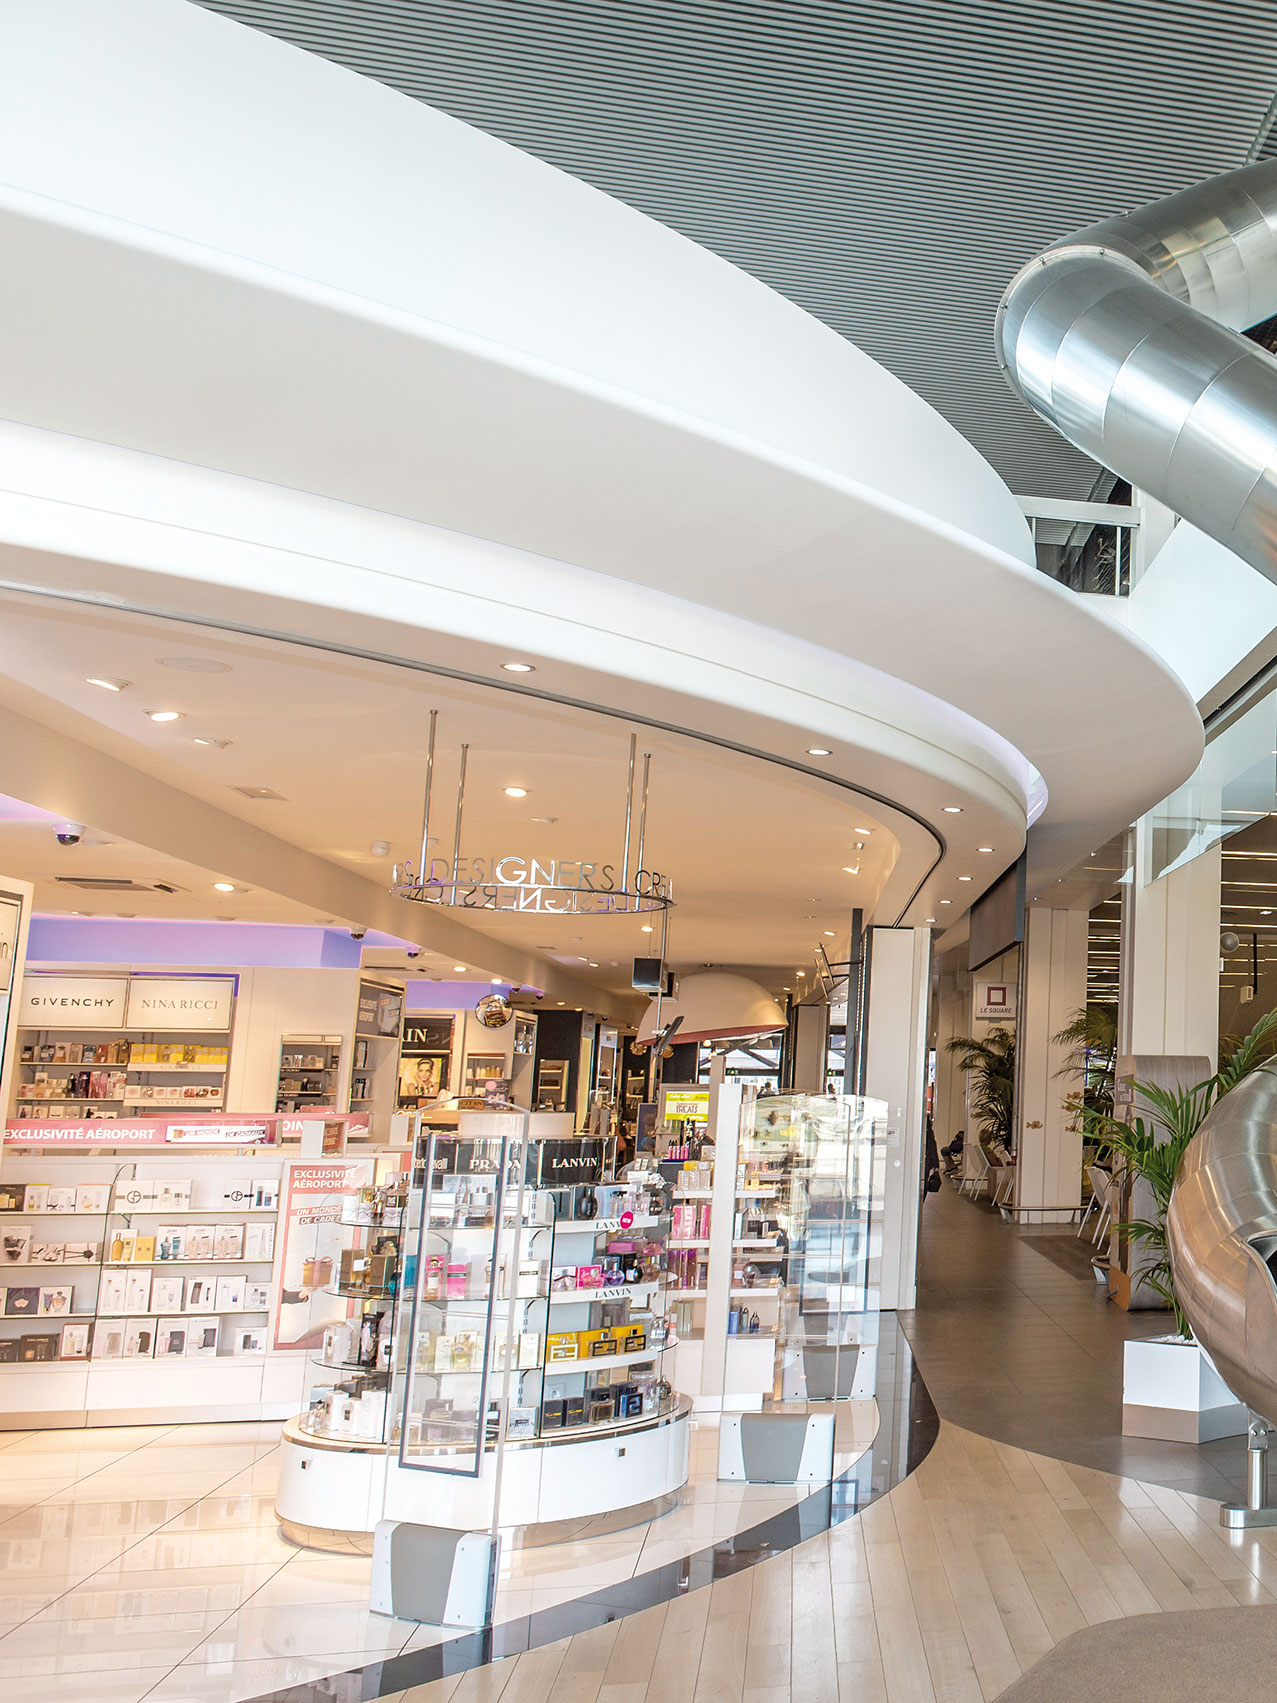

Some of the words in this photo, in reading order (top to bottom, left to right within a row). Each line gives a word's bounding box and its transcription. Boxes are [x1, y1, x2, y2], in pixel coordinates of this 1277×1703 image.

[430, 856, 614, 891] DESIGNERS
[30, 998, 115, 1007] GIVENCHY
[141, 999, 176, 1009] NINA
[179, 1000, 219, 1010] RICCI
[3, 1126, 84, 1140] EXCLUSIVITÉ
[86, 1126, 156, 1140] AÉROPORT
[469, 1159, 521, 1169] PRADA
[551, 1157, 599, 1169] LANVIN
[294, 1168, 356, 1179] EXCLUSIVITÉ
[292, 1179, 347, 1189] AÉROPORT
[311, 1205, 341, 1215] MONDE
[301, 1217, 312, 1225] DE
[596, 1221, 620, 1229] LANV
[595, 1286, 632, 1299] LANVIN
